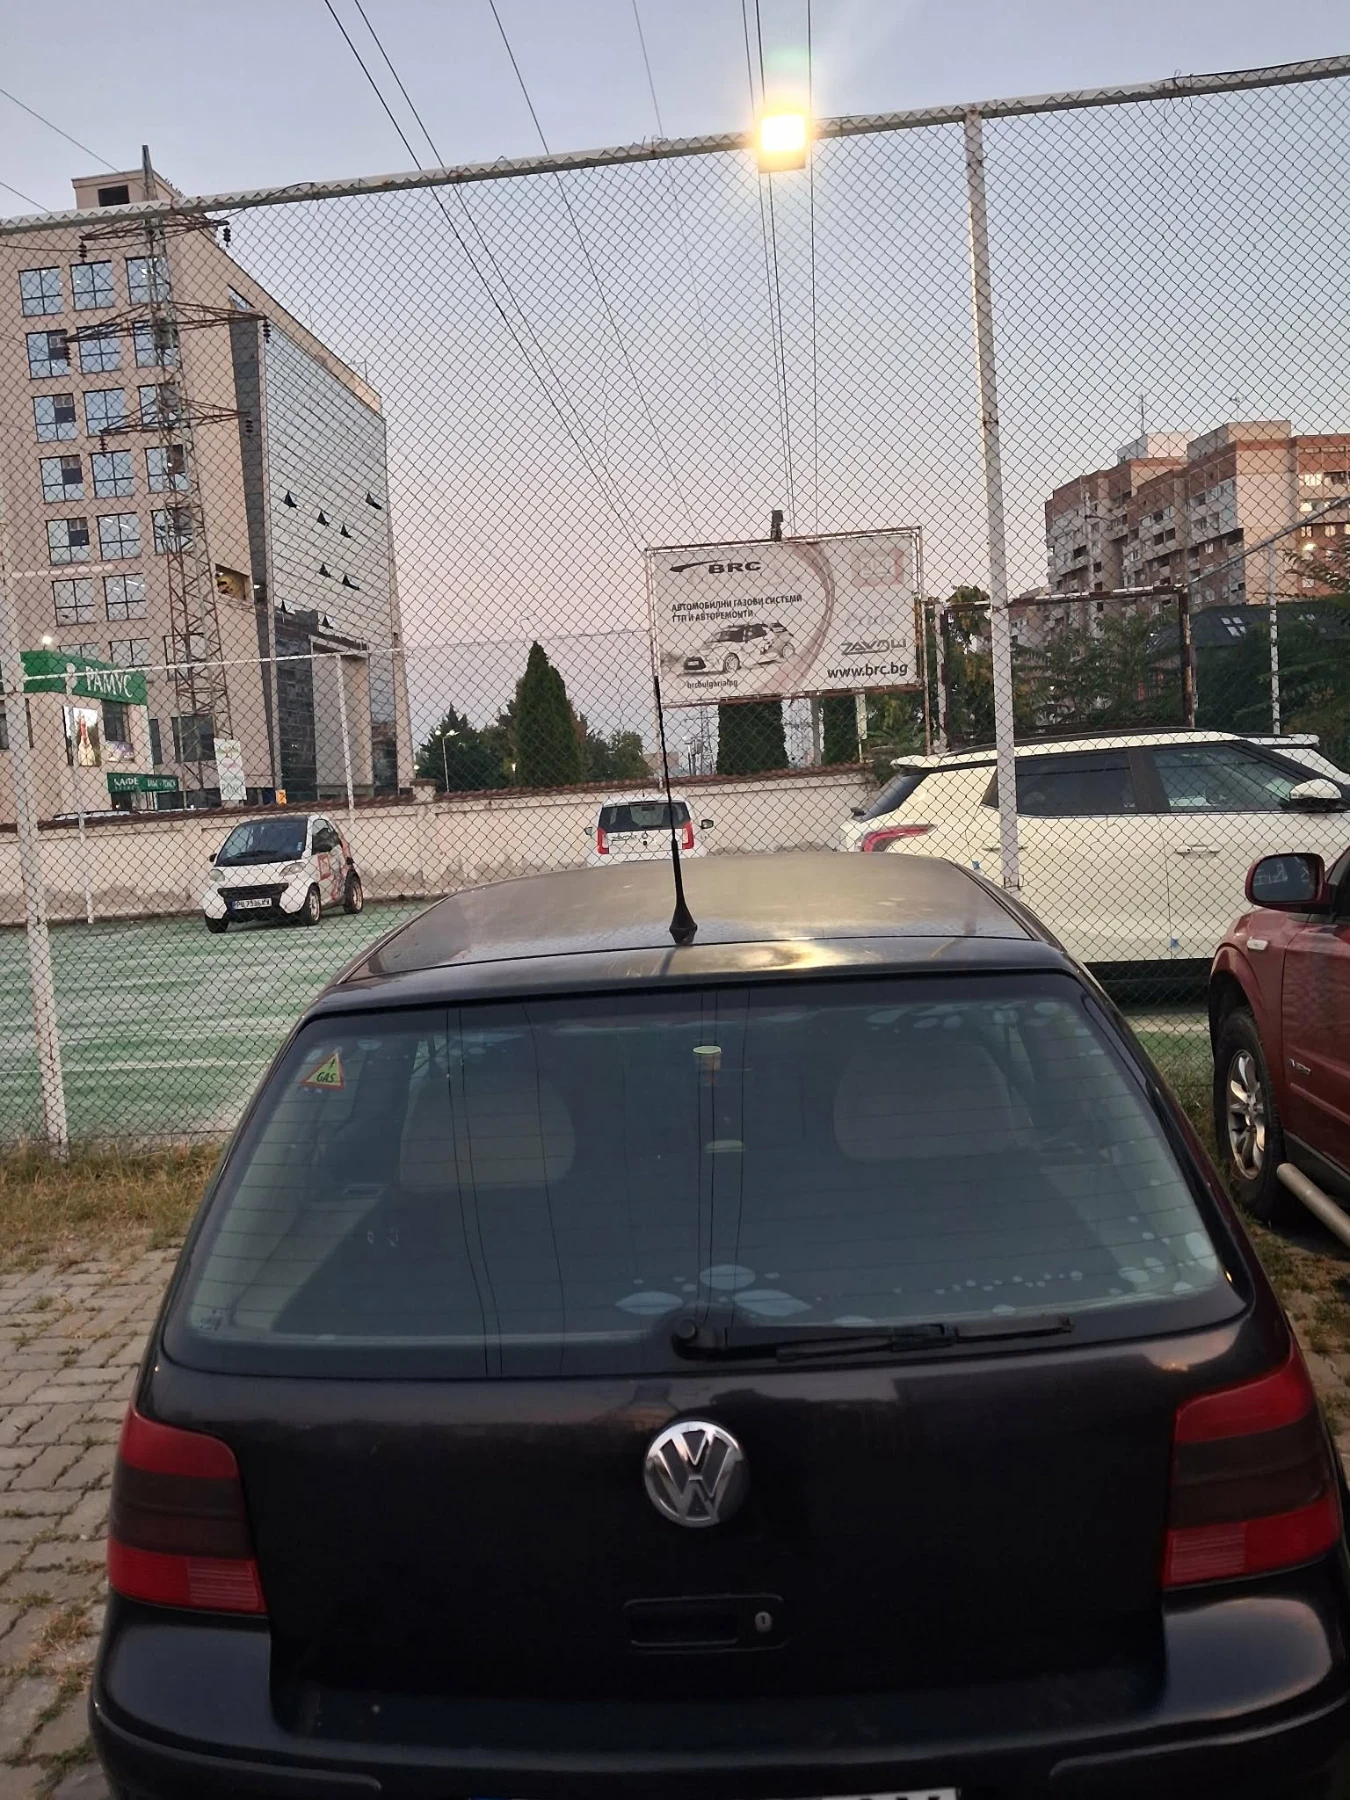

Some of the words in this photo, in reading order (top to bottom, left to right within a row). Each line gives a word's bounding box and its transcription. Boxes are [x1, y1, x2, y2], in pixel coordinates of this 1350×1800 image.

[708, 561, 761, 574] BRC
[671, 599, 732, 612] АВТОМОБИЛНИ
[733, 597, 763, 609] ГАЗОВИ
[765, 594, 803, 605] СИСТЕМИ
[688, 612, 694, 622] И
[695, 609, 753, 621] АВТОРЕМОНТИ
[827, 661, 908, 679] www.brc.bg
[85, 665, 134, 698] РАМУС
[316, 1071, 337, 1084] GAS
